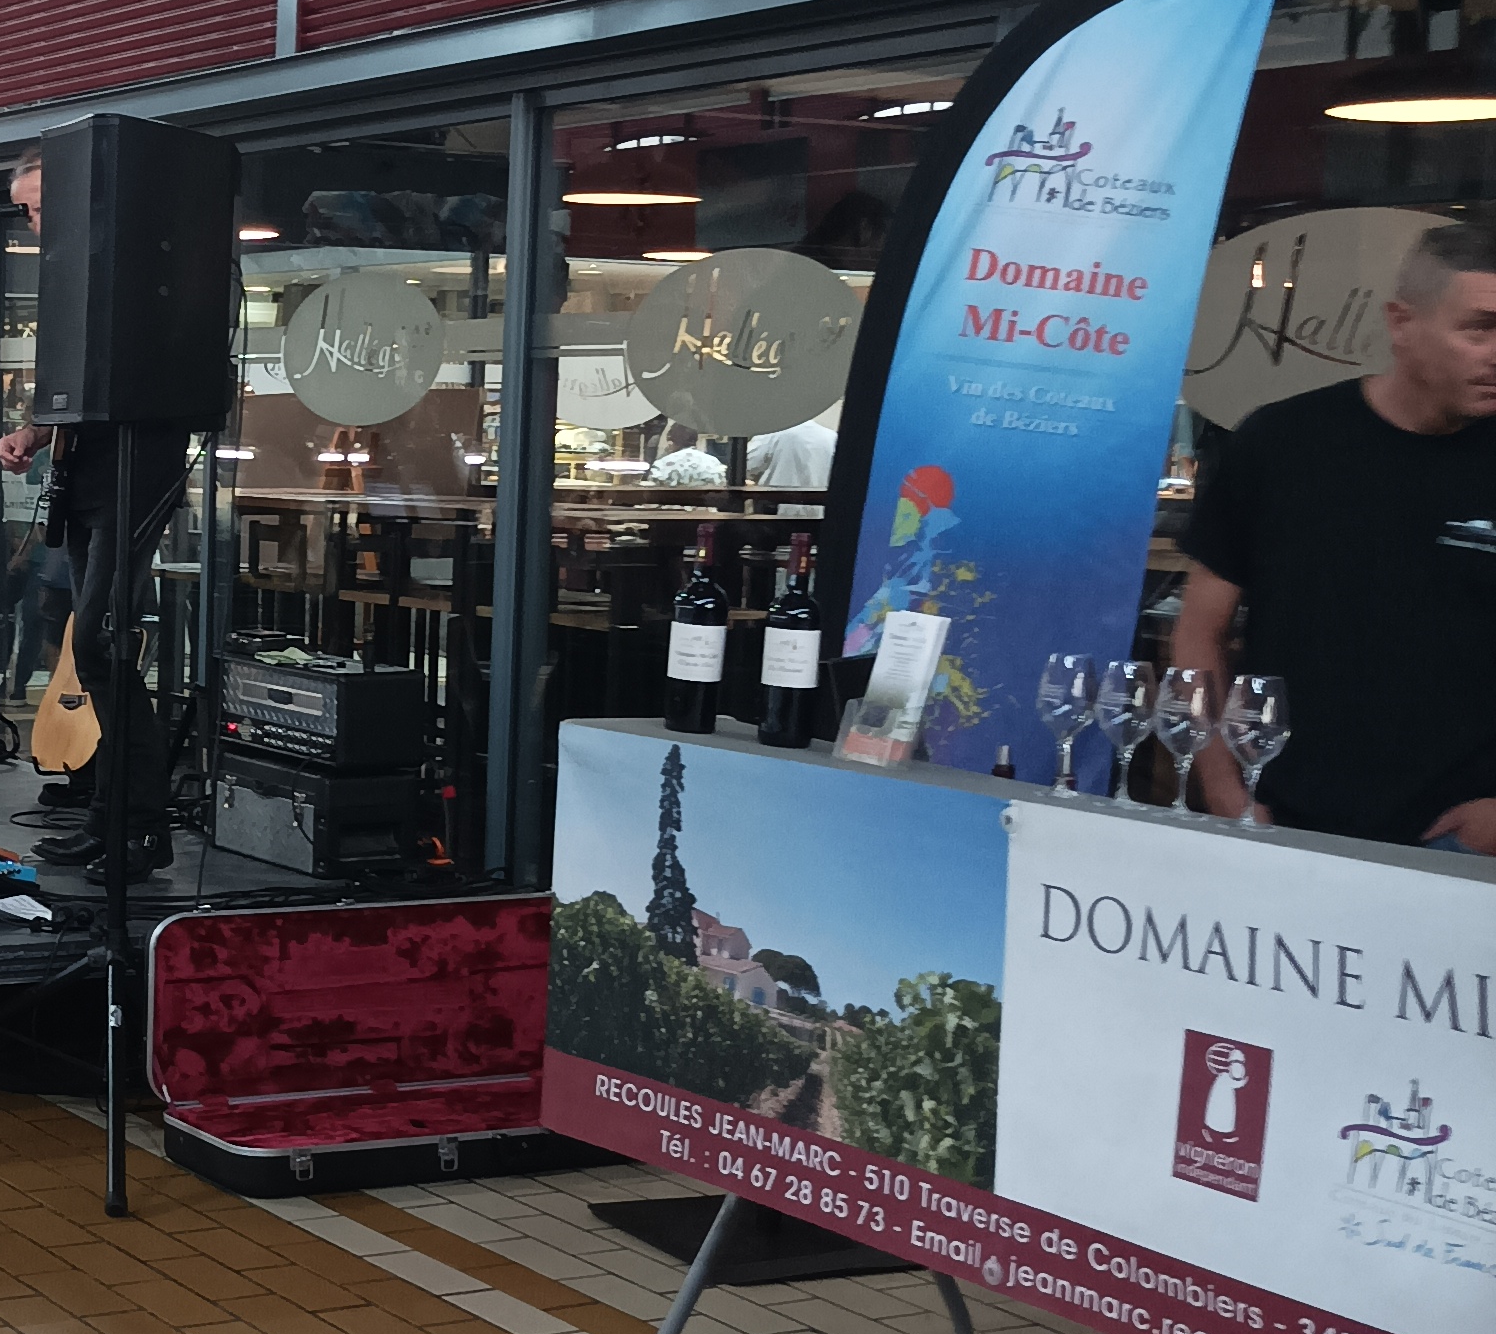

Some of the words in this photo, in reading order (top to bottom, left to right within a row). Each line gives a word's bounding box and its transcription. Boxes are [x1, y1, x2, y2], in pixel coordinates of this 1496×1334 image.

[1076, 168, 1176, 196] Coteaux
[965, 247, 1149, 301] Domaine
[959, 304, 1131, 356] Mi-Côte
[1040, 882, 1365, 1010] DOMAINE
[595, 1074, 703, 1128] RECOULES
[708, 1113, 842, 1176] JEAN-MARC
[864, 1165, 910, 1201] 510
[918, 1182, 1032, 1243] Traverse
[1040, 1229, 1078, 1260] de
[1088, 1242, 1264, 1329] Colombiers
[660, 1129, 696, 1163] Tél.
[718, 1151, 744, 1180] 04
[750, 1164, 777, 1191] 67
[784, 1175, 813, 1205] 28
[820, 1188, 849, 1218] 85
[856, 1201, 886, 1232] 73
[910, 1220, 982, 1269] Email
